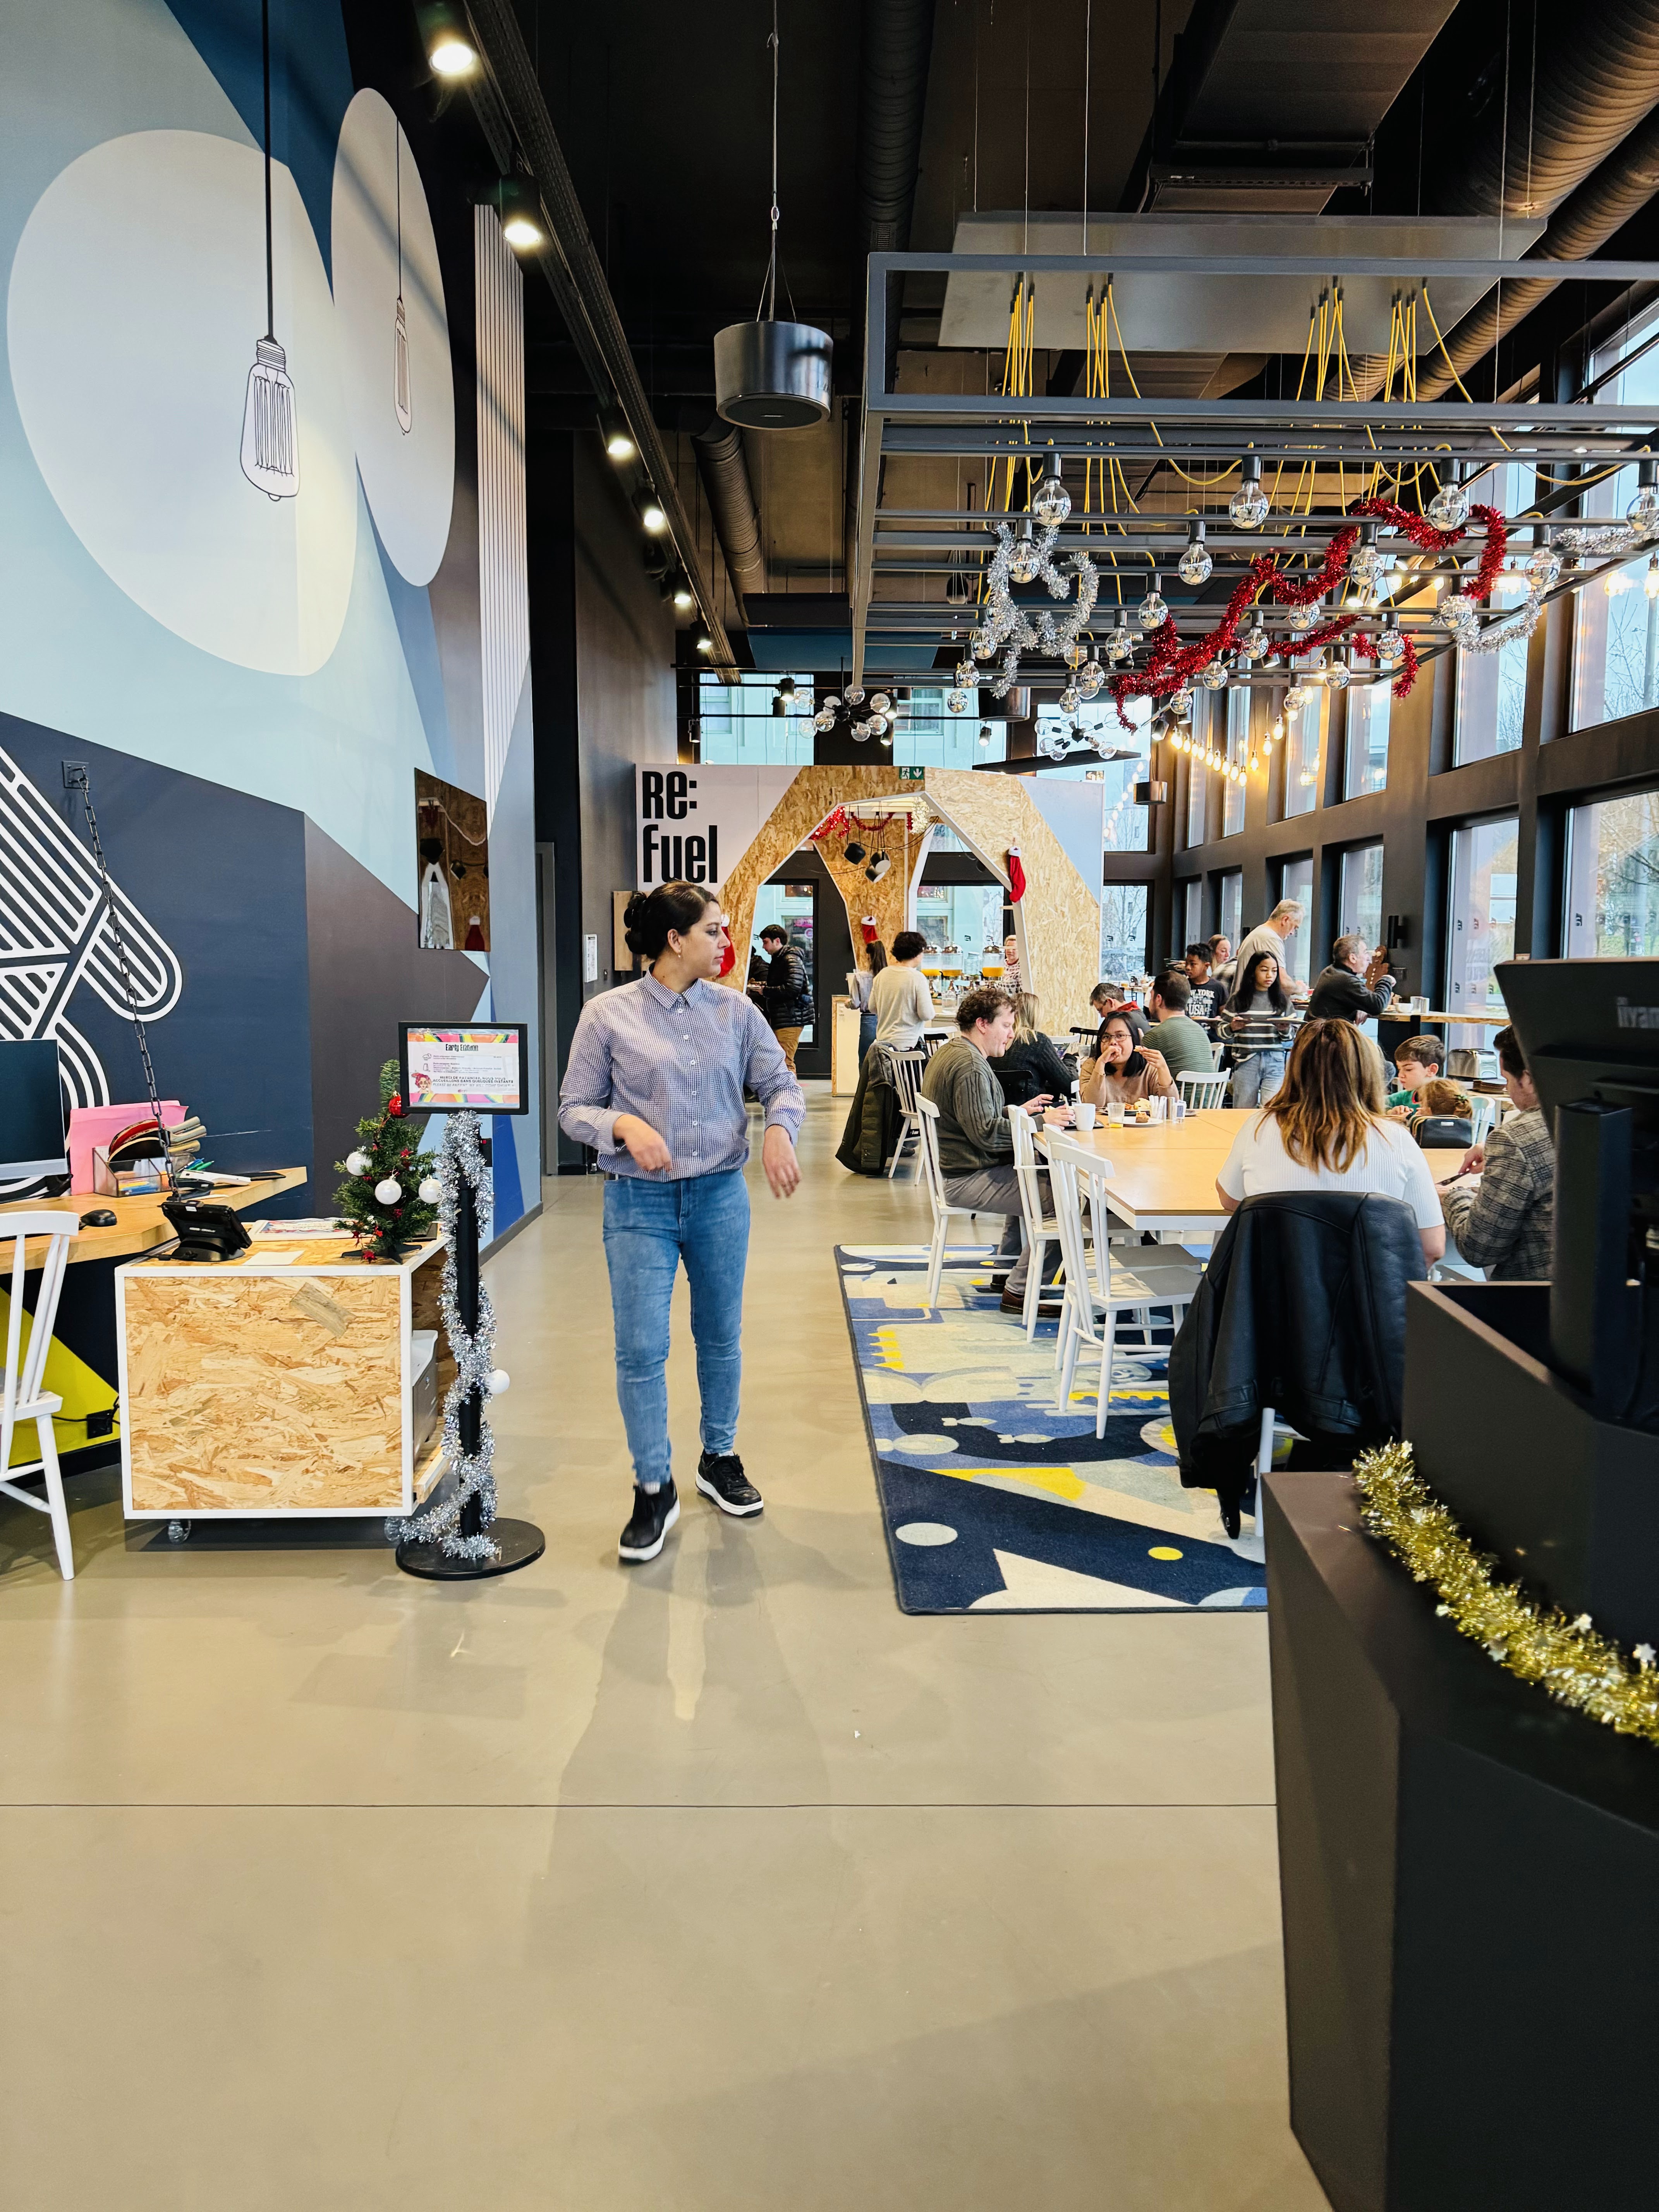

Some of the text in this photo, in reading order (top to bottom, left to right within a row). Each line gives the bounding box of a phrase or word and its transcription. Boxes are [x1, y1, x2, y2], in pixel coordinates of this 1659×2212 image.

[642, 771, 697, 819] Re:
[1197, 989, 1214, 998] YORK
[1188, 1004, 1205, 1015] USA
